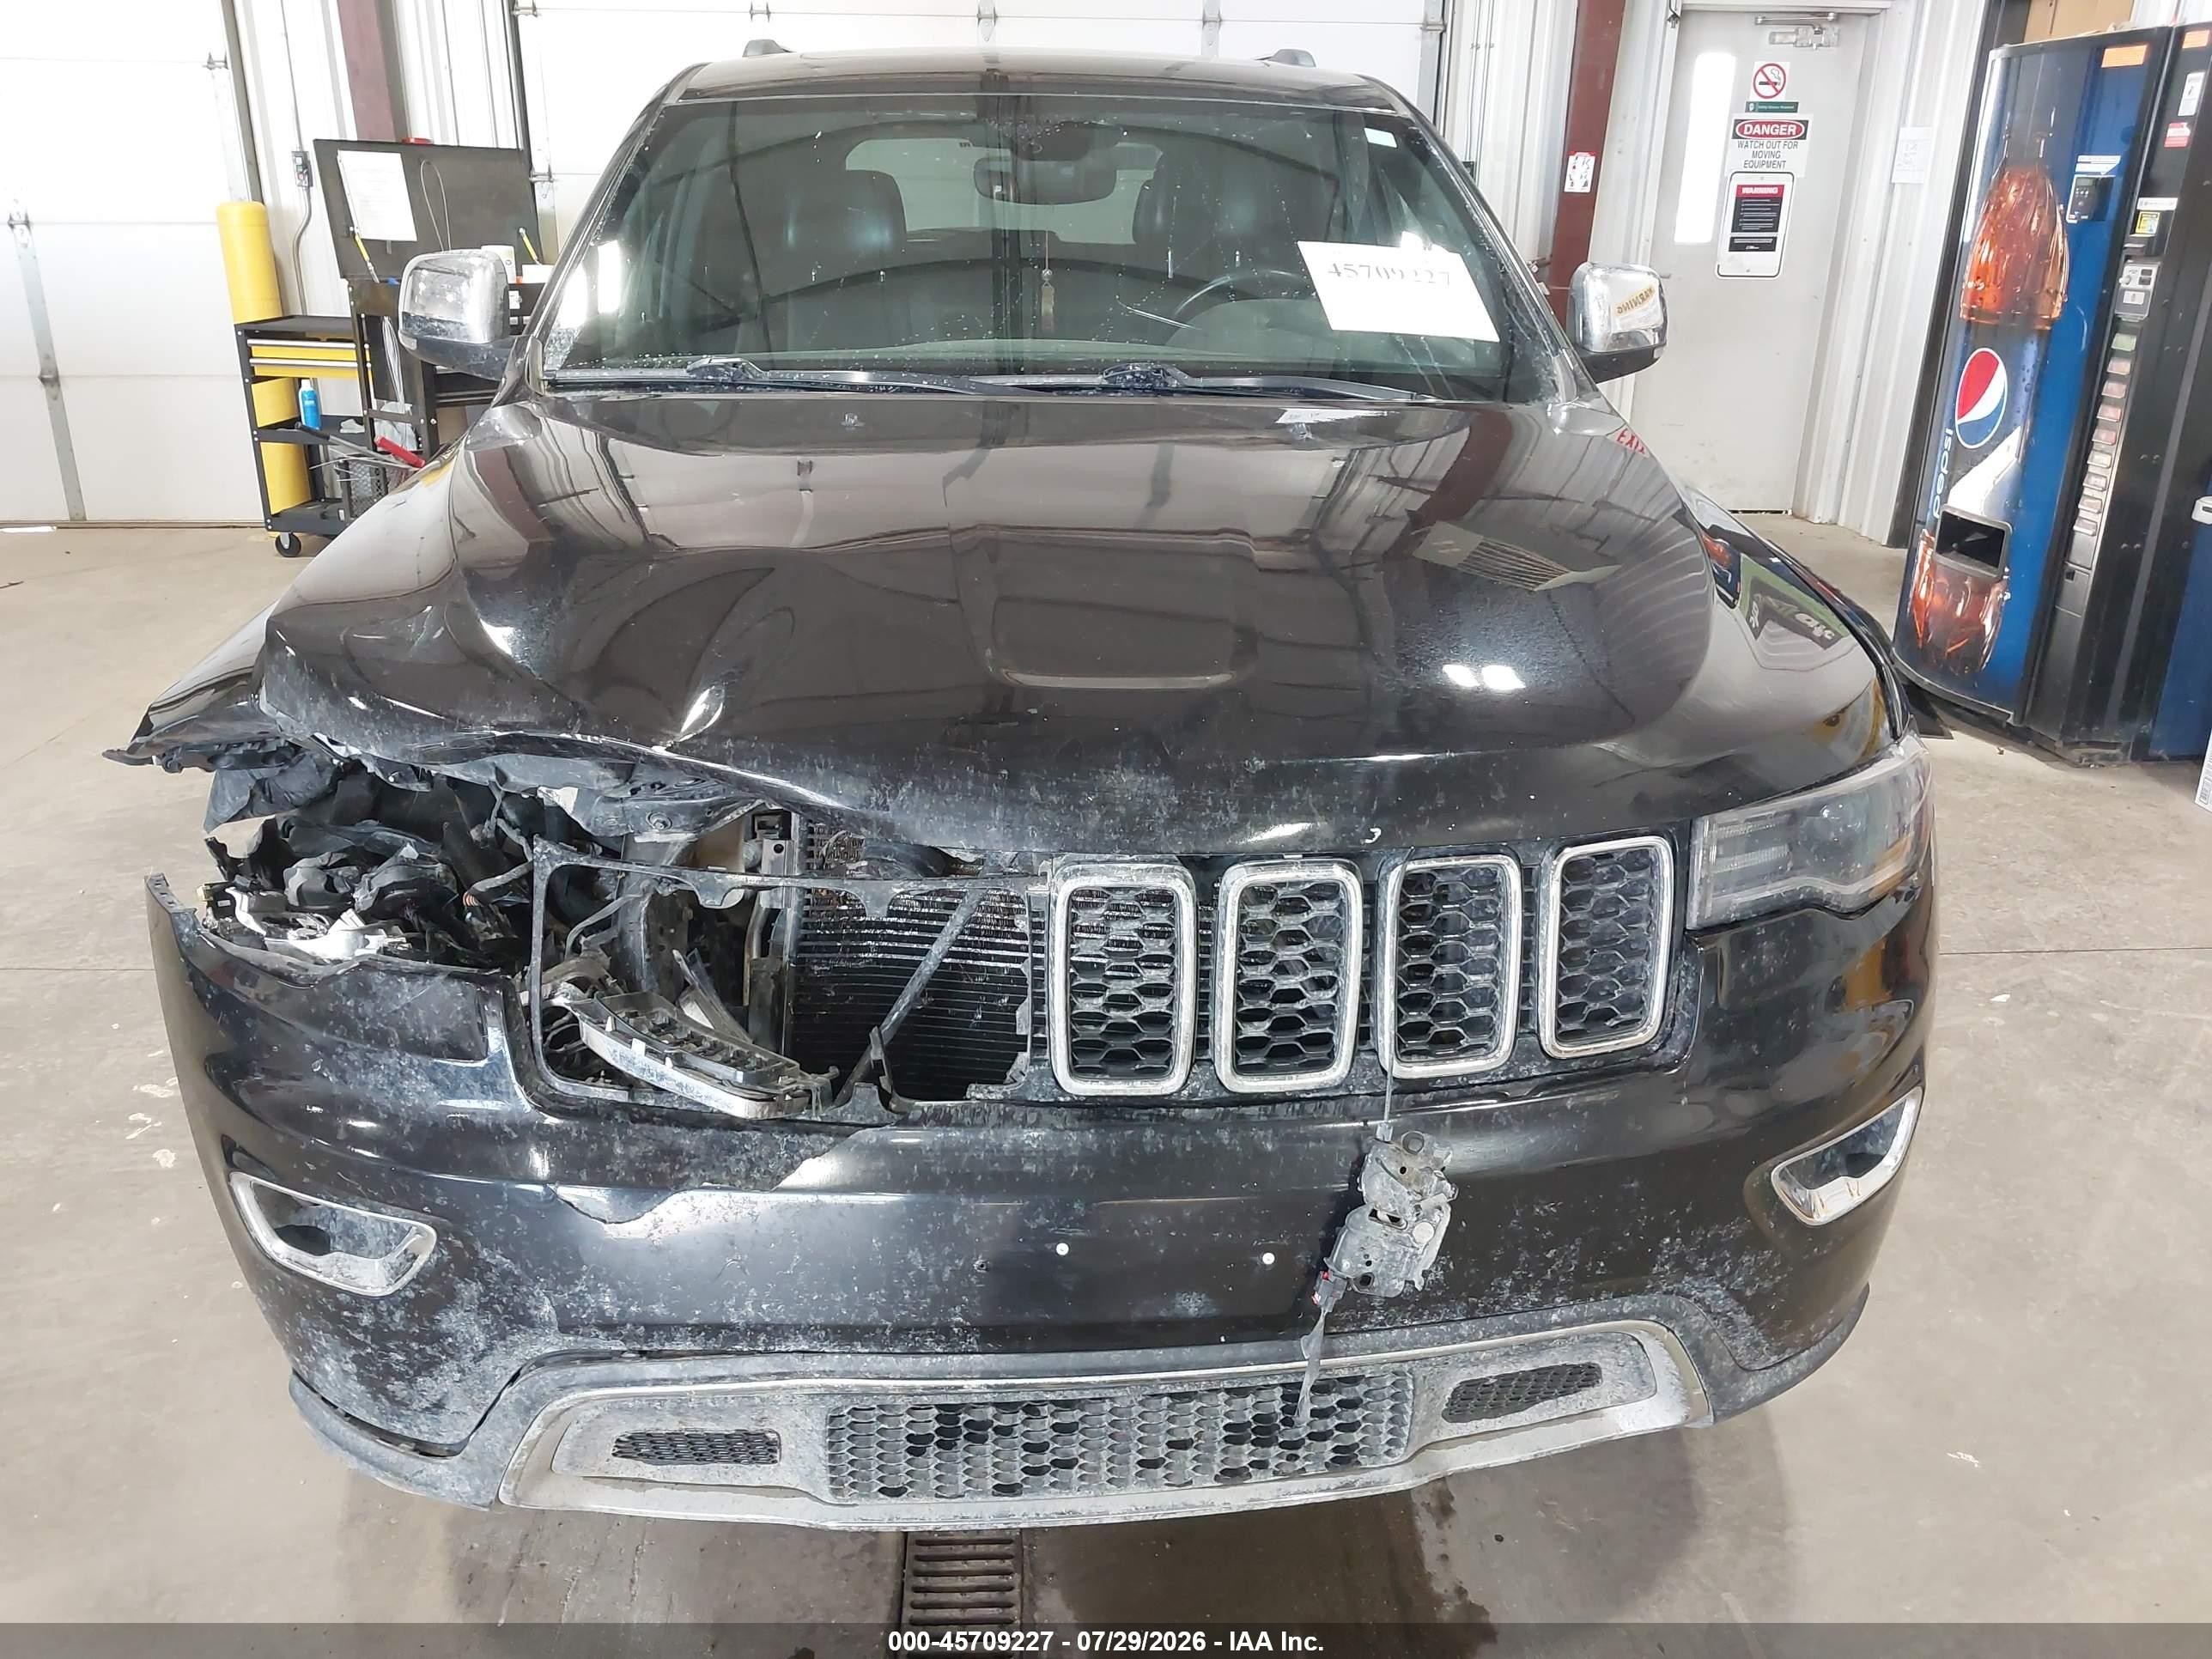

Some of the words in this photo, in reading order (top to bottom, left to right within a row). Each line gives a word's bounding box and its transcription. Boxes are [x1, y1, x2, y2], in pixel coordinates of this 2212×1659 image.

[1743, 124, 1797, 136] DANGER
[1737, 140, 1764, 149] WATCH
[1765, 141, 1782, 149] OUT
[1783, 141, 1799, 149] FOR
[1751, 150, 1781, 159] MOVING
[1743, 160, 1787, 169] EQUIPMENT
[1932, 428, 1954, 520] pepsi
